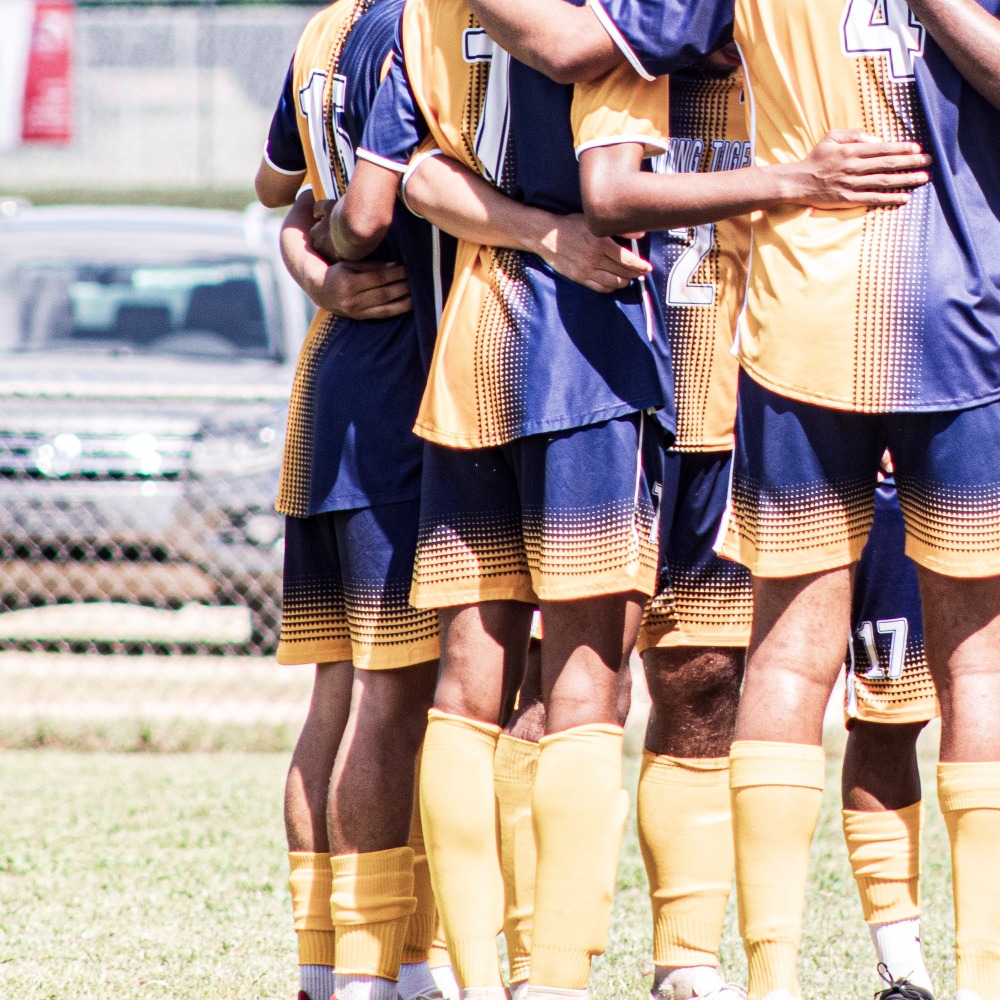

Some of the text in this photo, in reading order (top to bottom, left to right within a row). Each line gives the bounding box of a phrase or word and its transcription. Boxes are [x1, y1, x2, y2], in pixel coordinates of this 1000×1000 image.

[298, 68, 354, 200] 15
[462, 27, 511, 189] 7
[857, 617, 909, 679] 17
